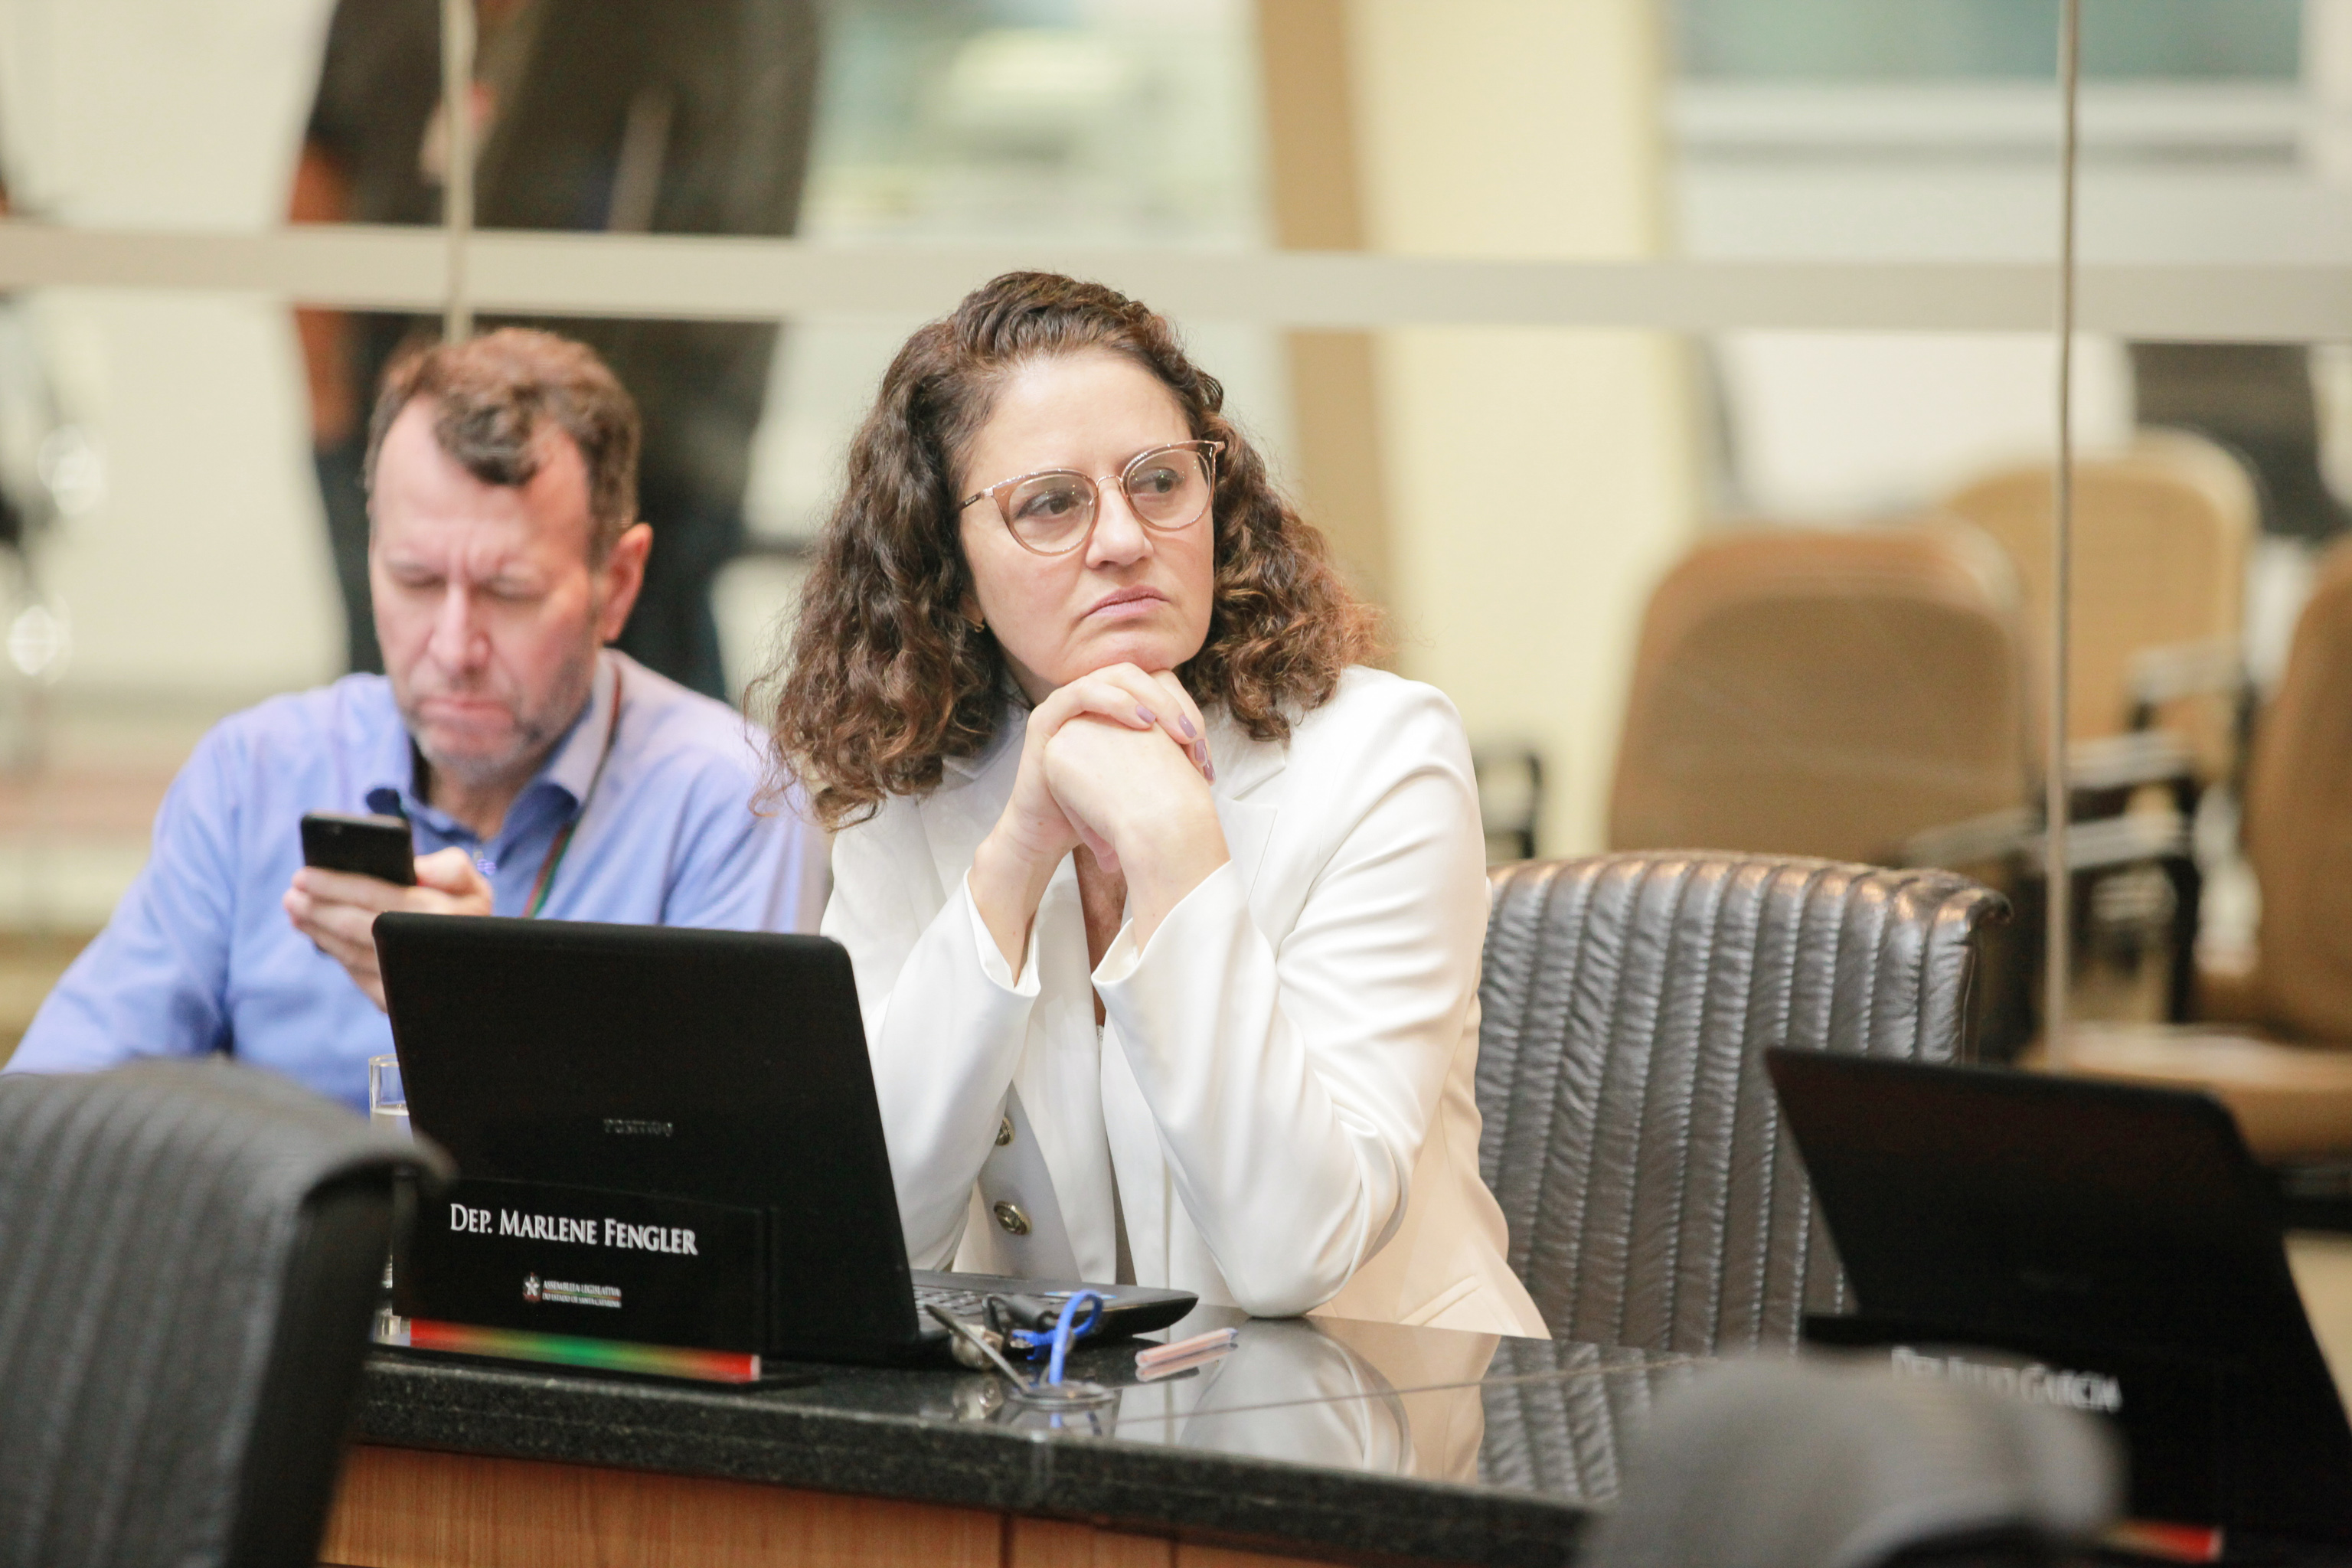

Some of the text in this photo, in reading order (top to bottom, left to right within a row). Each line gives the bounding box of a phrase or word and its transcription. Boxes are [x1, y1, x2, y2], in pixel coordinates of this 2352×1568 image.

[449, 1203, 698, 1256] DEP. MARLENE FENGLER
